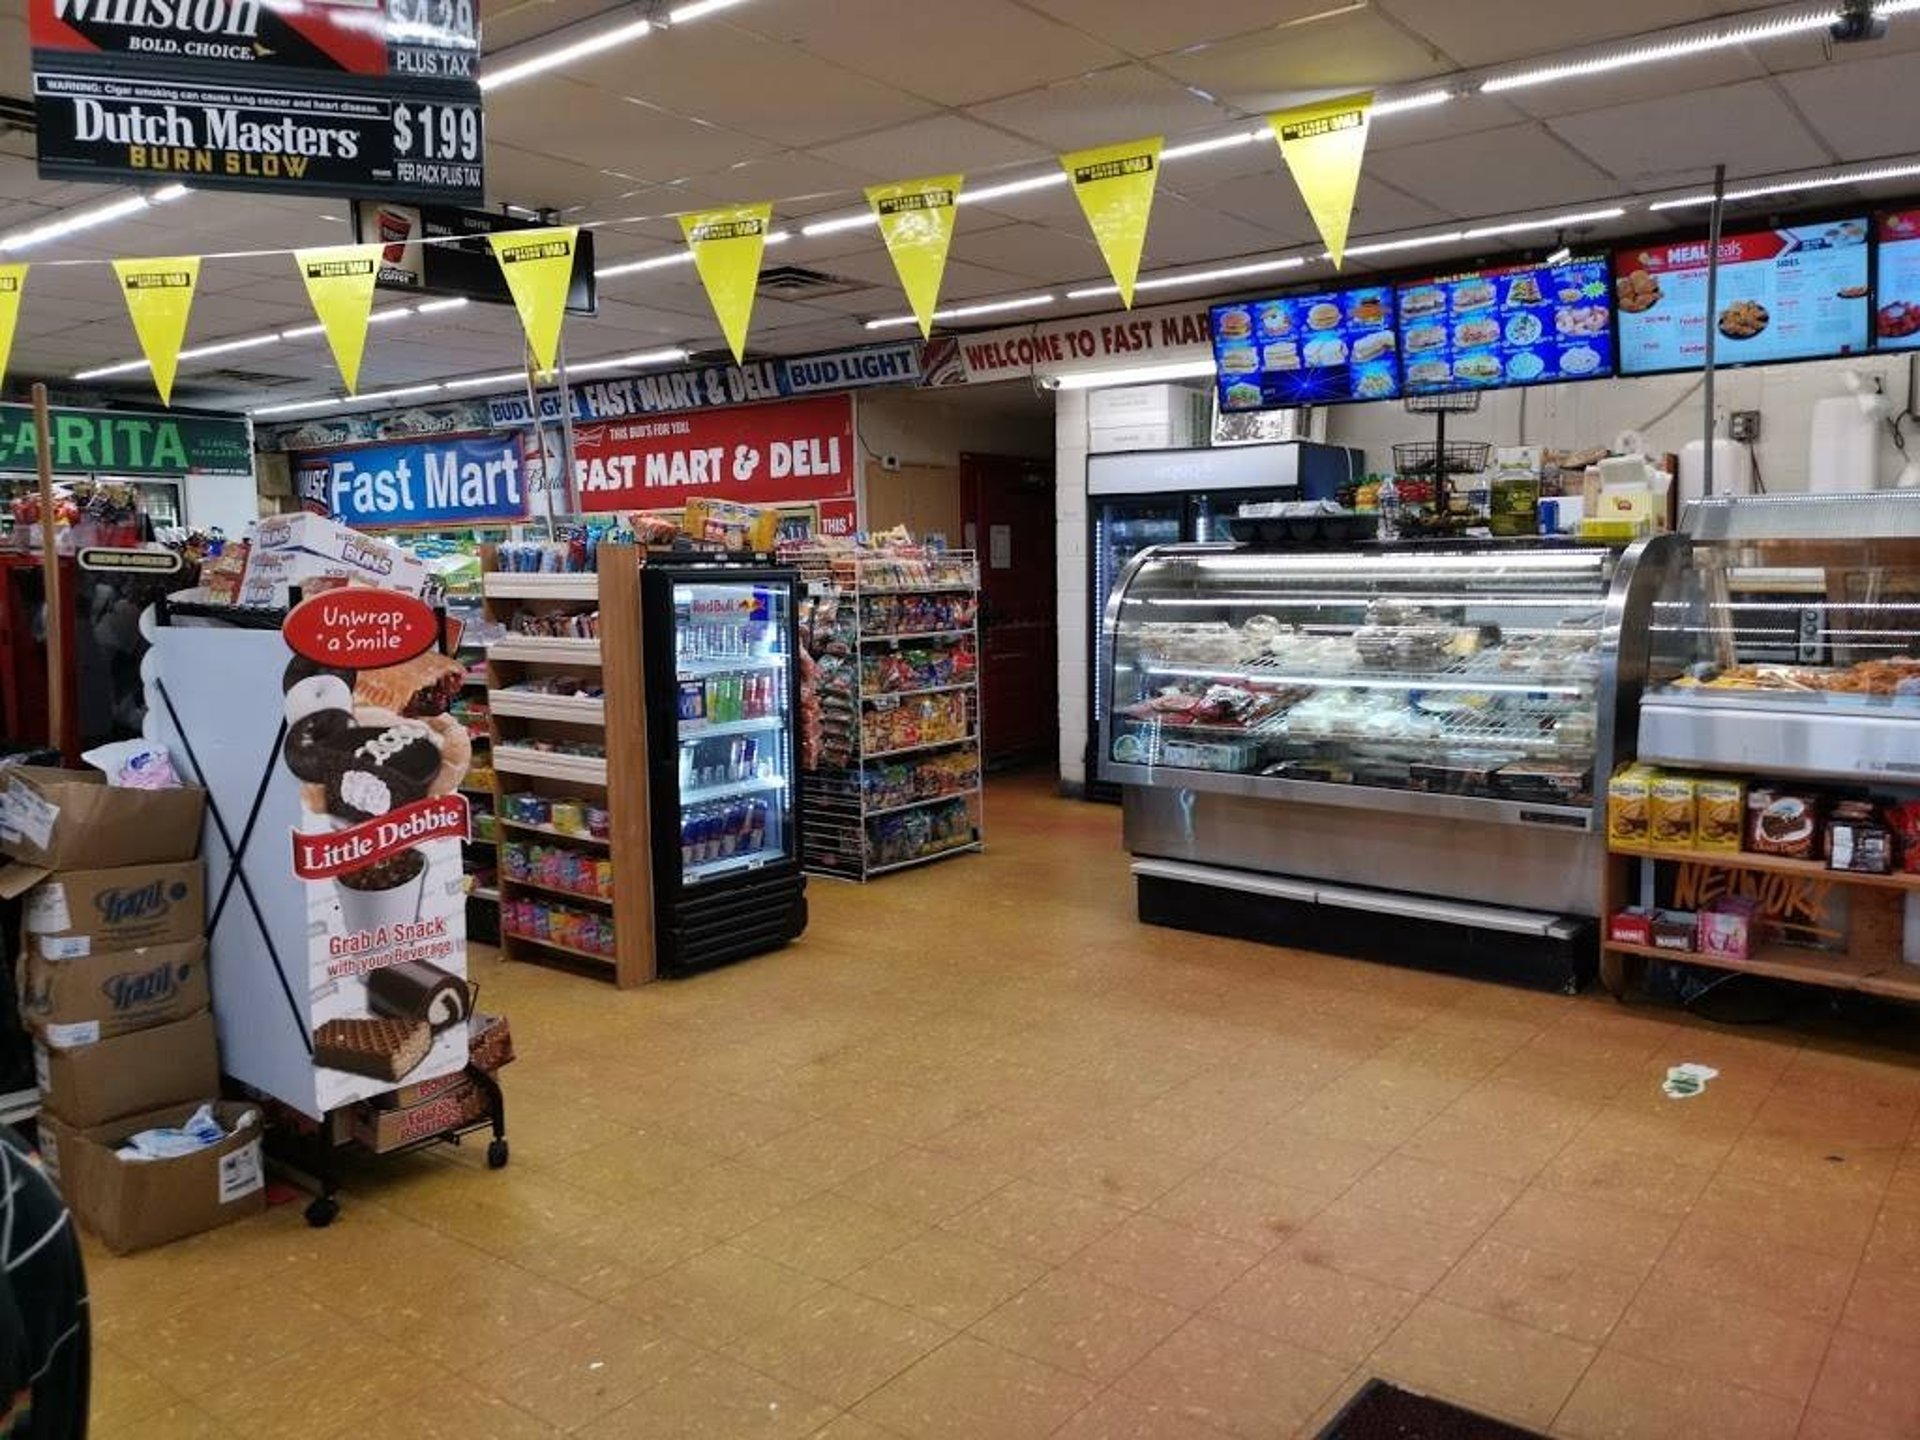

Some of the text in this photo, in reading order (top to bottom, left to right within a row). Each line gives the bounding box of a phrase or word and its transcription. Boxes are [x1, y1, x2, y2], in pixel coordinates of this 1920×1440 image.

[129, 36, 255, 60] BOLD. CHOICE.
[397, 50, 470, 77] PLUS TAX
[73, 97, 358, 159] Dutch Masters
[393, 102, 478, 160] $1.99
[129, 144, 309, 179] BURN SLOW
[397, 162, 415, 182] PER
[416, 163, 439, 184] PACK
[440, 165, 463, 187] PLUS
[464, 167, 481, 187] TAX
[965, 332, 1063, 371] WELCOME
[1067, 327, 1095, 359] TO
[1101, 320, 1154, 353] FAST
[491, 401, 523, 423] BUD
[583, 379, 636, 417] FAST
[636, 372, 702, 412] MART
[704, 368, 726, 406] &
[727, 361, 780, 402] DELI
[790, 360, 839, 387] BUD
[840, 352, 911, 380] LIGHT
[609, 426, 628, 441] THIS
[653, 422, 670, 436] FOR
[330, 459, 416, 517] Fast
[423, 449, 521, 510] Mart
[576, 455, 636, 493] FAST
[645, 447, 724, 488] MART
[733, 444, 758, 482] &
[770, 436, 842, 479] DELI
[822, 518, 847, 534] THIS
[323, 605, 404, 630] Unwrap
[327, 628, 402, 651] a Smile
[302, 807, 461, 871] Little Debbie
[329, 916, 446, 956] Grab A Snack
[327, 940, 452, 977] with your Beverage
